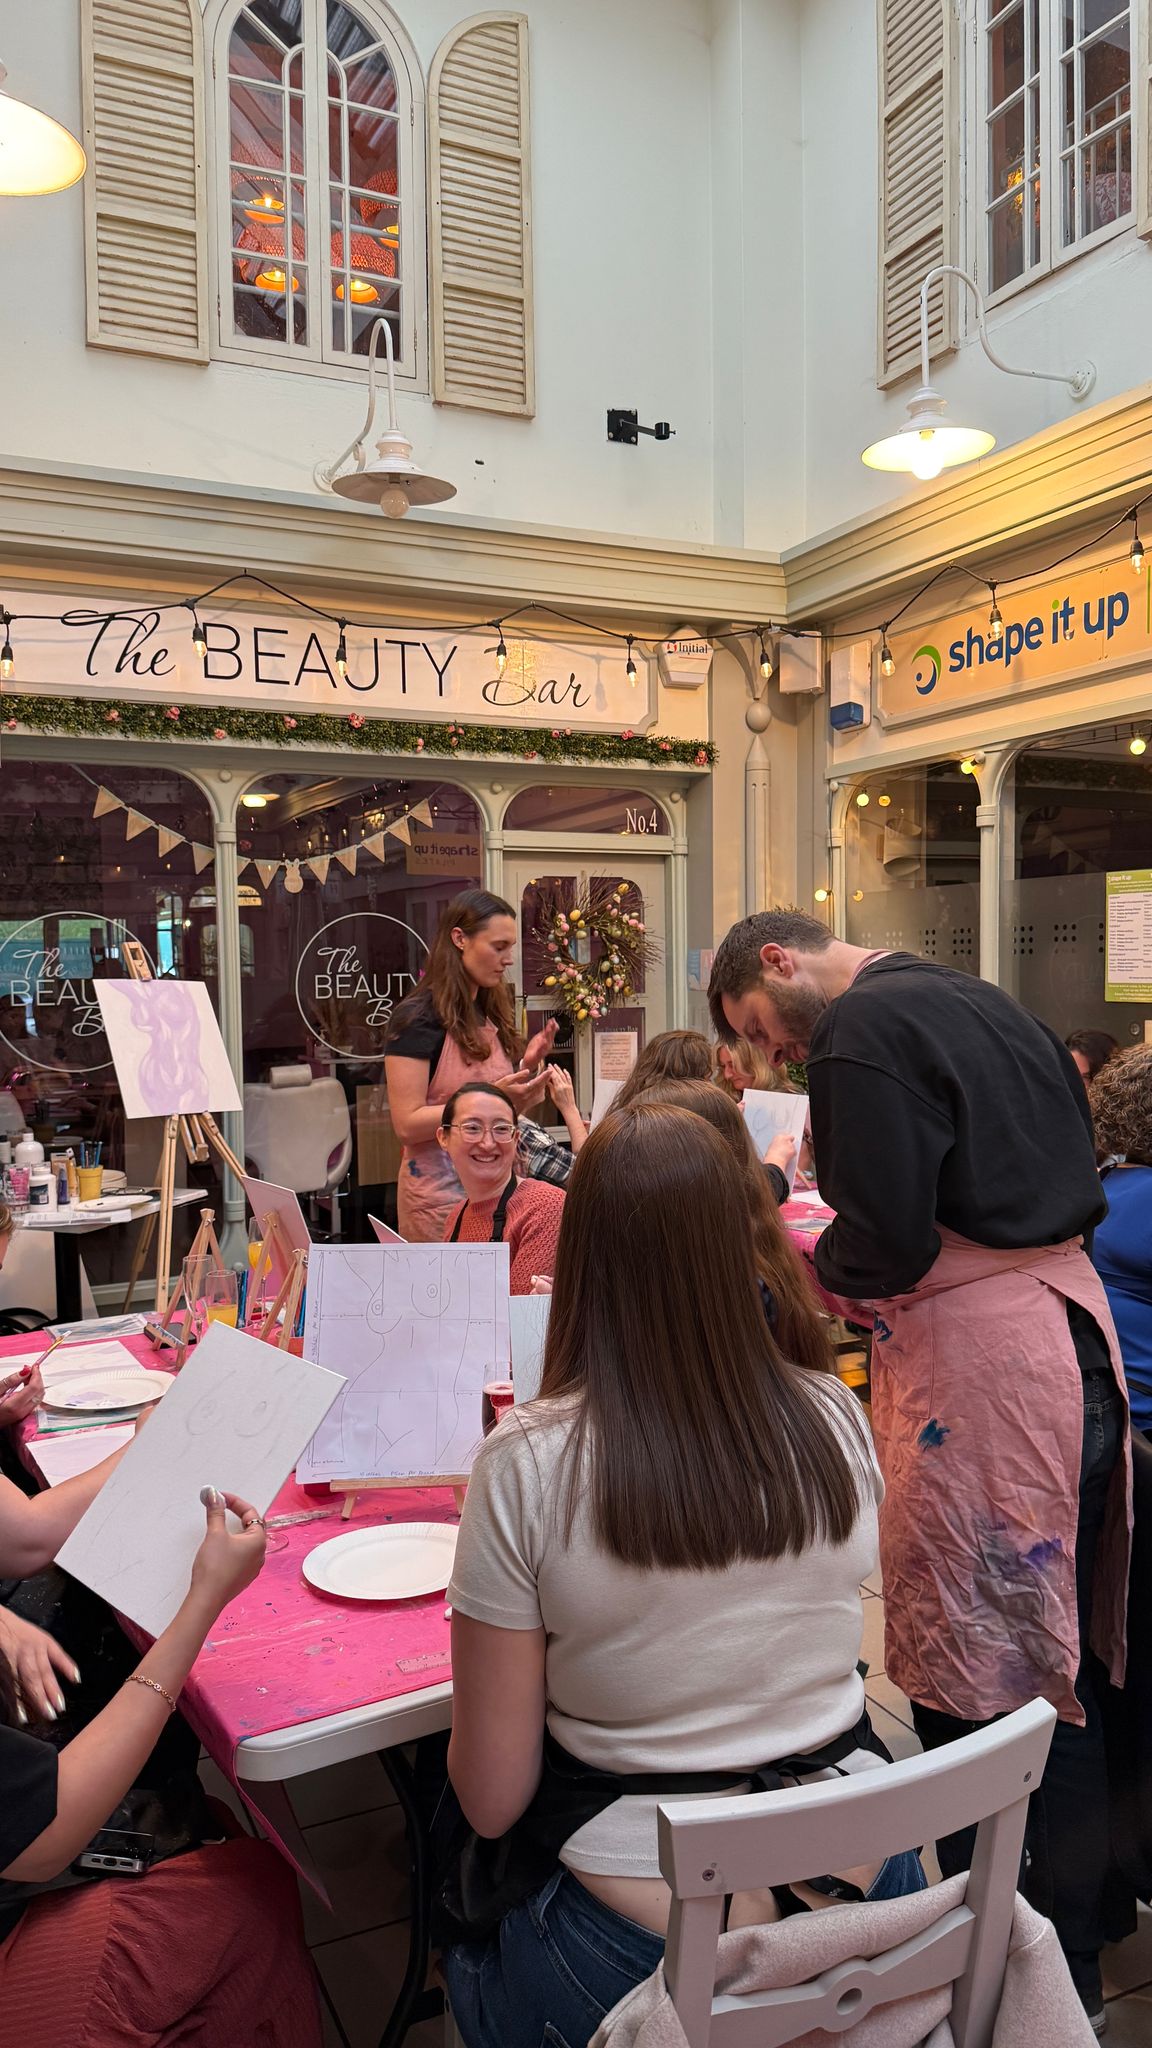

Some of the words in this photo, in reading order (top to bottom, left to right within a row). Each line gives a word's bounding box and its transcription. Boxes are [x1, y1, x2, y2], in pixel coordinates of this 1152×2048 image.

[949, 617, 1044, 673] shape
[1051, 597, 1075, 644] it
[1083, 591, 1130, 640] up
[60, 610, 176, 676] The
[202, 622, 458, 697] BEAUTY
[482, 645, 591, 707] Bar
[679, 642, 708, 655] Initial
[625, 807, 658, 833] No.4
[13, 947, 68, 979] The
[317, 945, 362, 975] The
[10, 979, 99, 1007] BEAU
